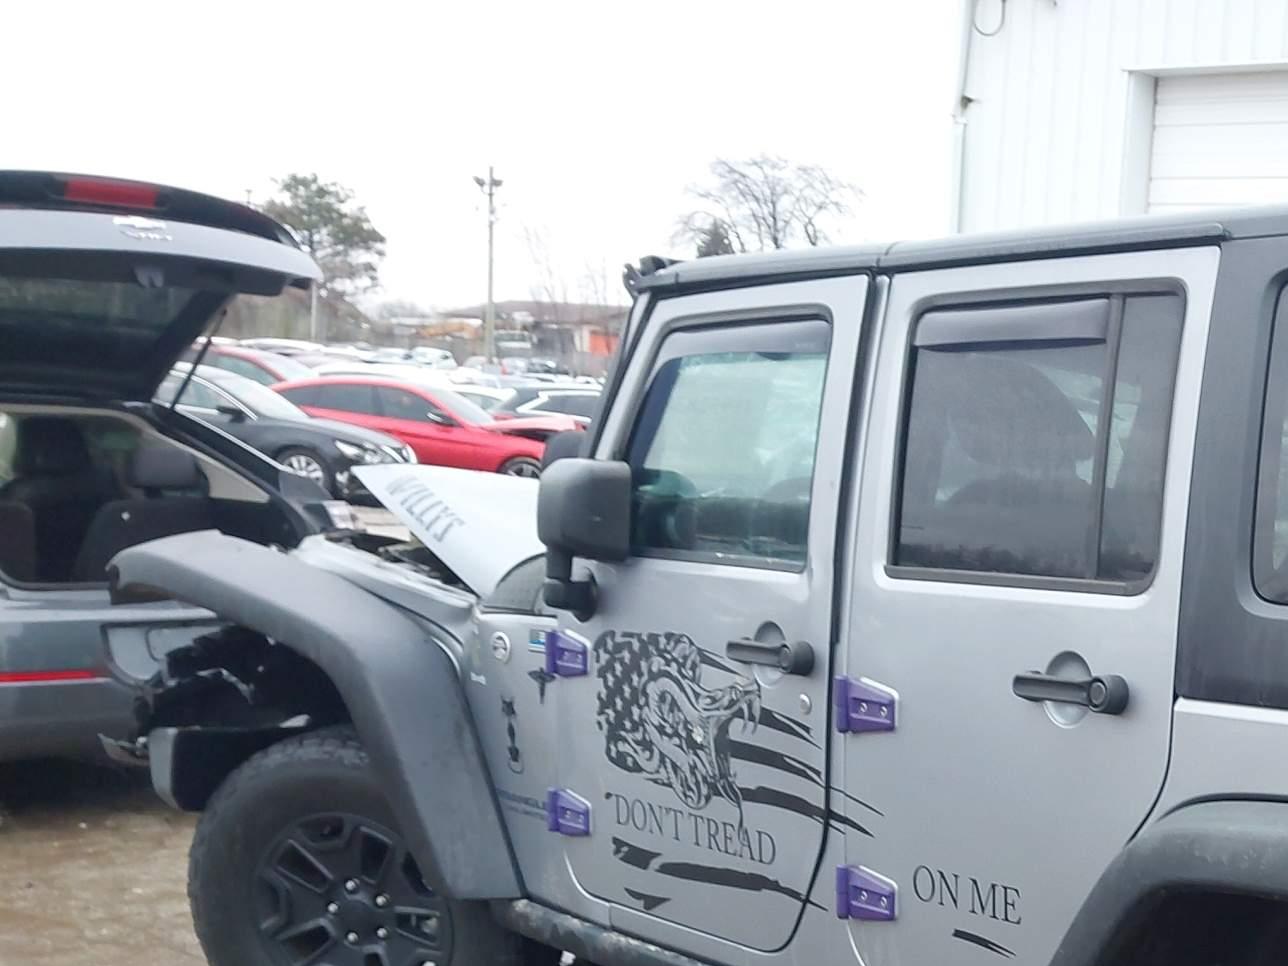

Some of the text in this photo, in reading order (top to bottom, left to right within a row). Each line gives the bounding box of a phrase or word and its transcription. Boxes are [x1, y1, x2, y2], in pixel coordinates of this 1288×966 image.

[614, 793, 777, 866] DON'T TREAD
[912, 864, 1022, 926] ON ME
